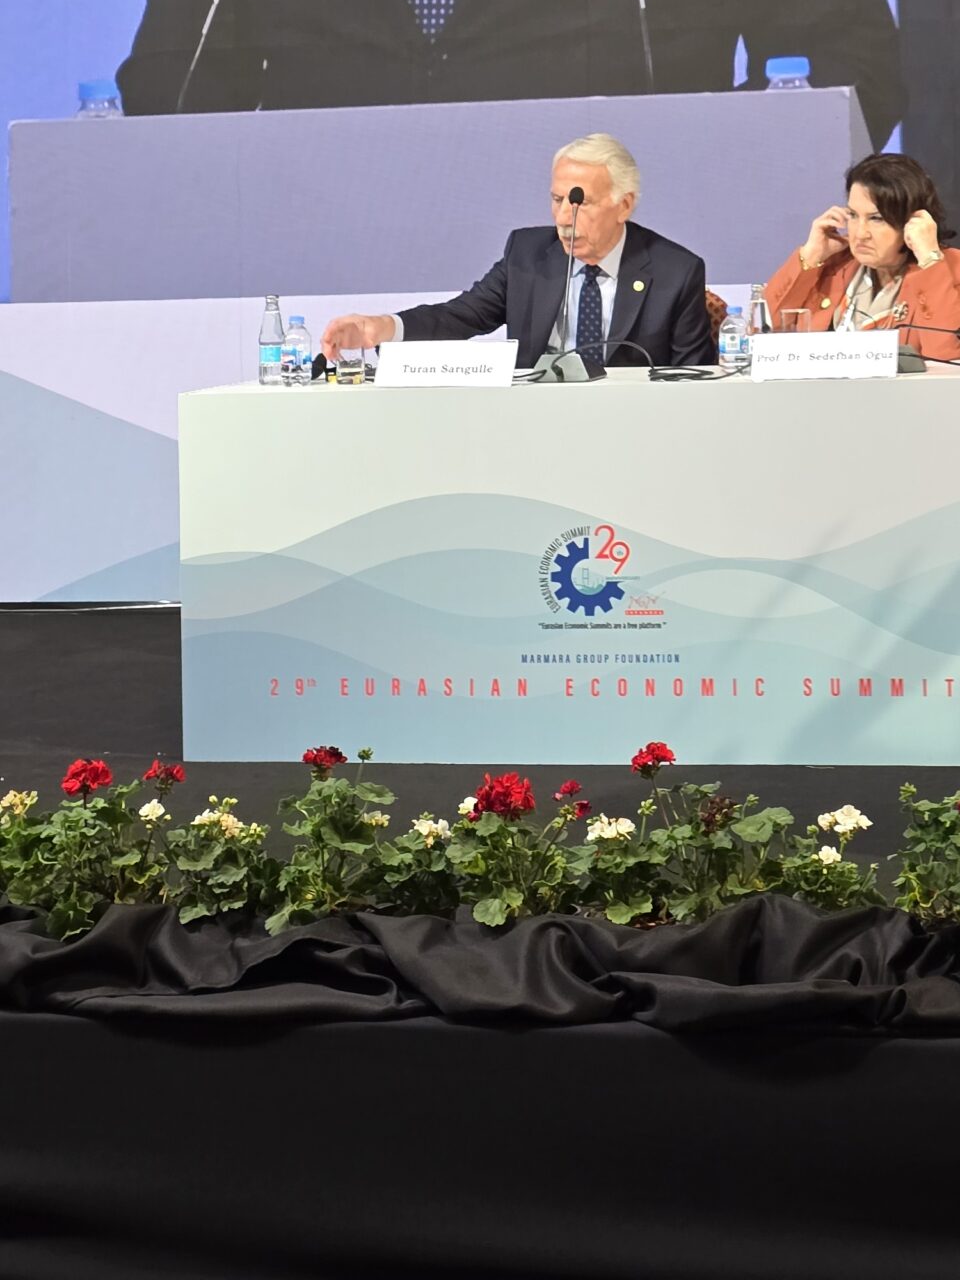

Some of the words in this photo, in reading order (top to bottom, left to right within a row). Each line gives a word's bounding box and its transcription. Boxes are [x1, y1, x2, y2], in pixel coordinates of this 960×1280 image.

[402, 364, 436, 374] Turan
[561, 526, 591, 542] SUMMIT
[538, 537, 563, 575] ECONOMIC
[594, 525, 630, 575] 29
[538, 577, 562, 614] EURASIAN
[520, 654, 571, 664] MARMARA
[576, 654, 609, 663] GROUP
[615, 654, 680, 663] FOUNDATION
[340, 678, 528, 697] EURASIAN
[565, 678, 765, 697] ECONOMIC
[803, 678, 955, 697] SUMMIT
